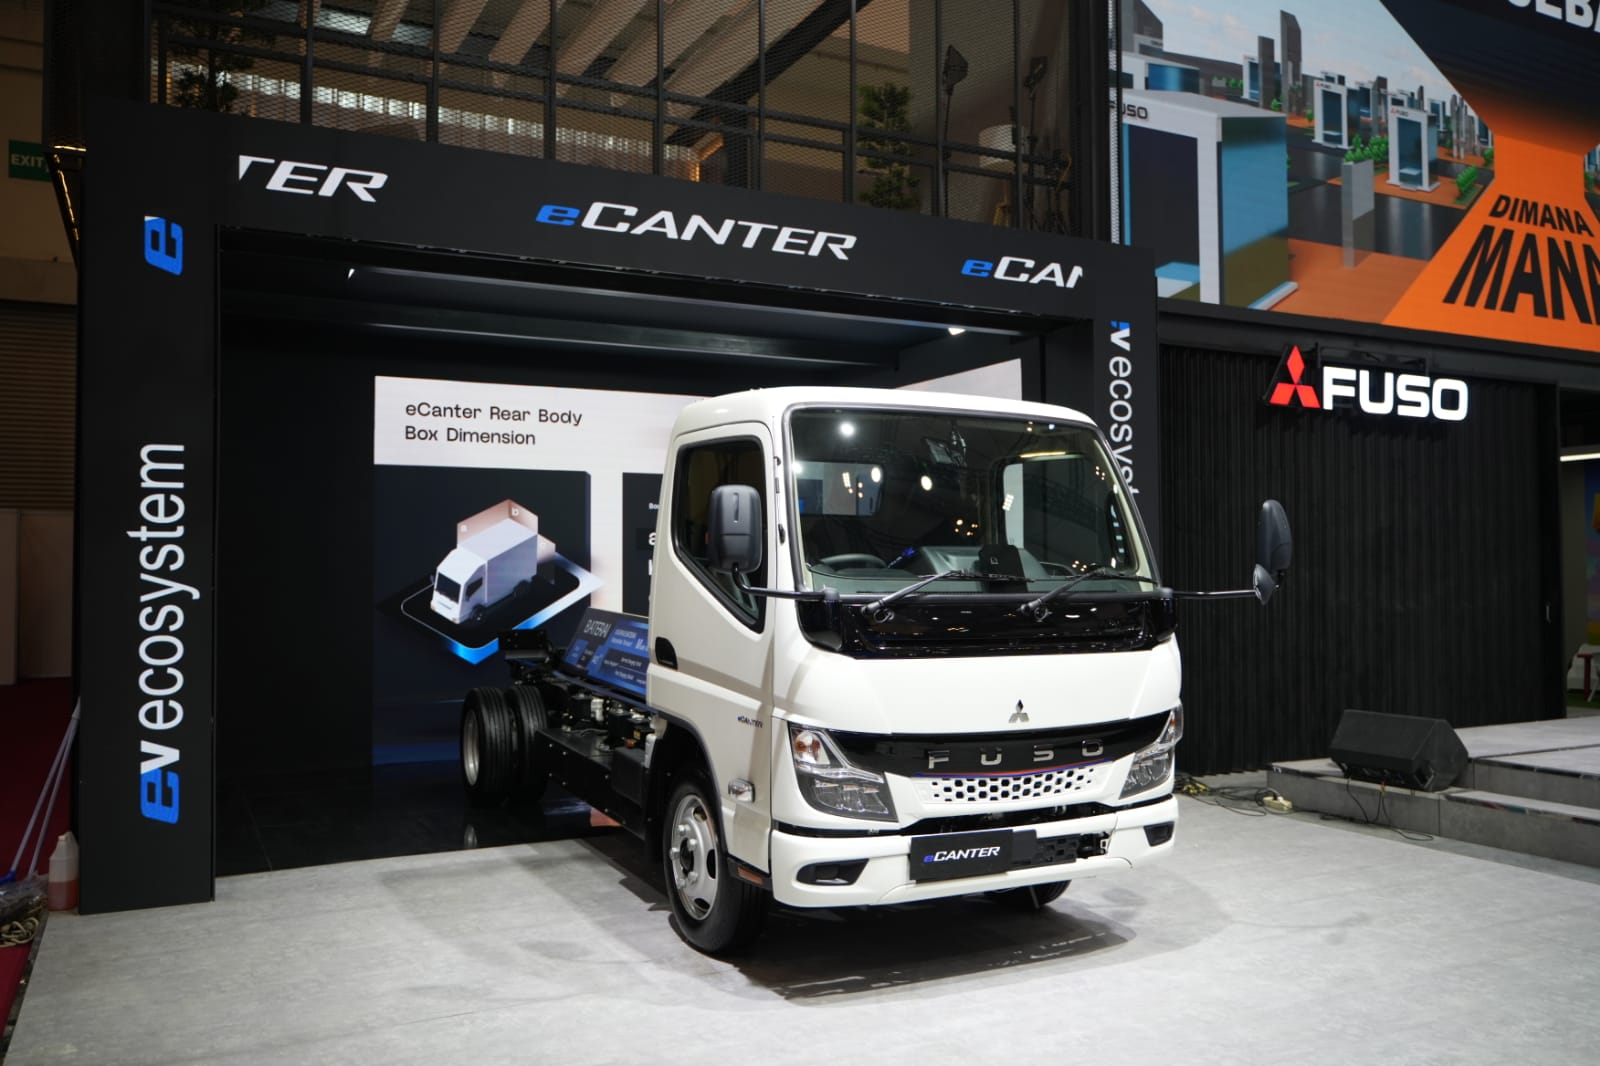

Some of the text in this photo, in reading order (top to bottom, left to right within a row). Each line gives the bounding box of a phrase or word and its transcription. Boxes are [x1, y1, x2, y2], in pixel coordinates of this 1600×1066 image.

[11, 153, 45, 168] EXIT
[536, 202, 857, 260] eCANTER
[1489, 194, 1594, 237] DIMANA
[1323, 366, 1468, 421] FUSO
[405, 402, 583, 426] eCanter Rear Body
[405, 425, 536, 445] Box Dimension
[126, 444, 200, 824] ev ecosystem
[928, 738, 1104, 769] FUSO
[923, 846, 1001, 863] eCANTER
